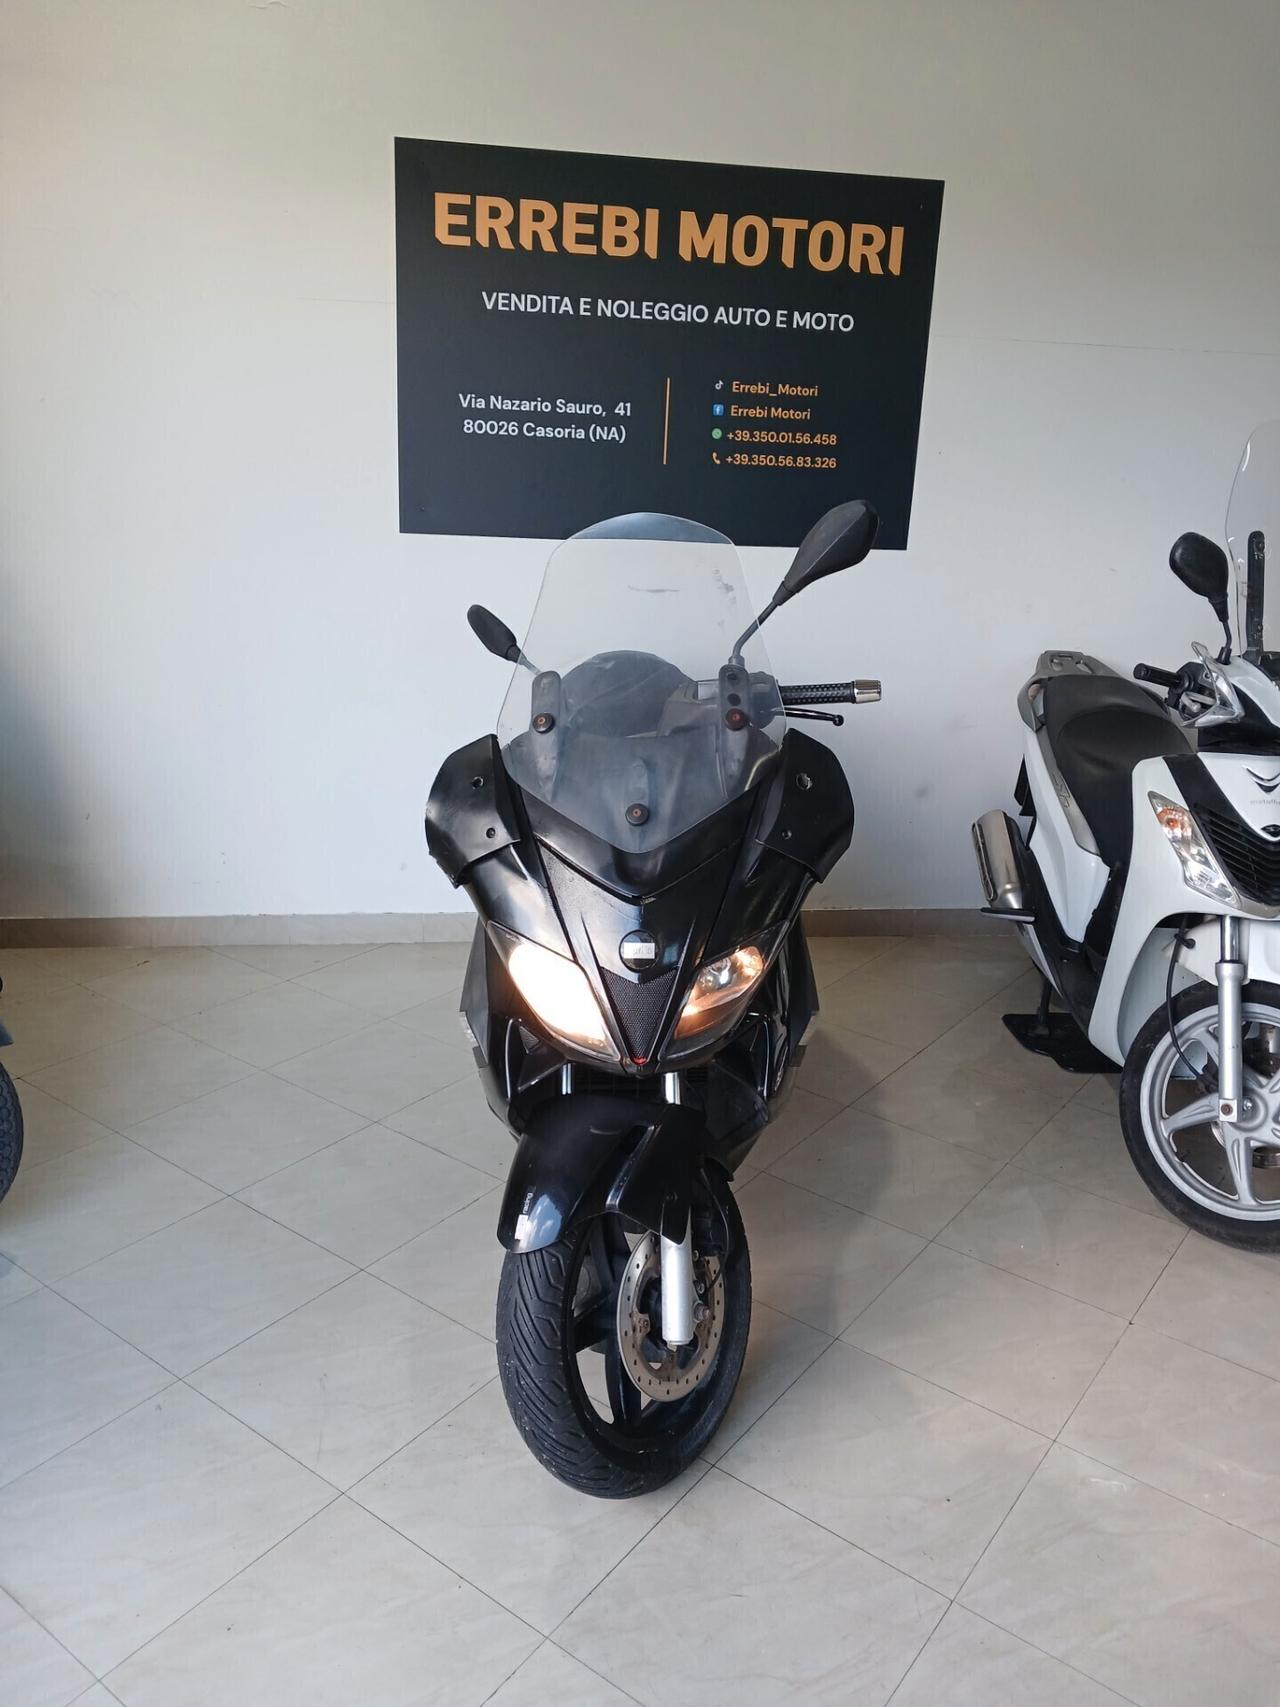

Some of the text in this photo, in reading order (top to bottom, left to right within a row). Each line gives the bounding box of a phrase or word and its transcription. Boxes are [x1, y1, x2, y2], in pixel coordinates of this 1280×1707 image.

[434, 191, 905, 277] ERREBI MOTORI
[481, 291, 855, 332] VENDITA E NOLEGGIO AUTO E MOTO
[732, 380, 818, 397] Errebi_Motori
[458, 392, 631, 418] Via Nazario Sauro, 41
[730, 404, 811, 420] Errebi Motori
[462, 418, 626, 444] 80026 Casoria (NA)
[726, 429, 837, 446] +39.350.01.56.458
[725, 453, 837, 469] +39.350.56.83.326
